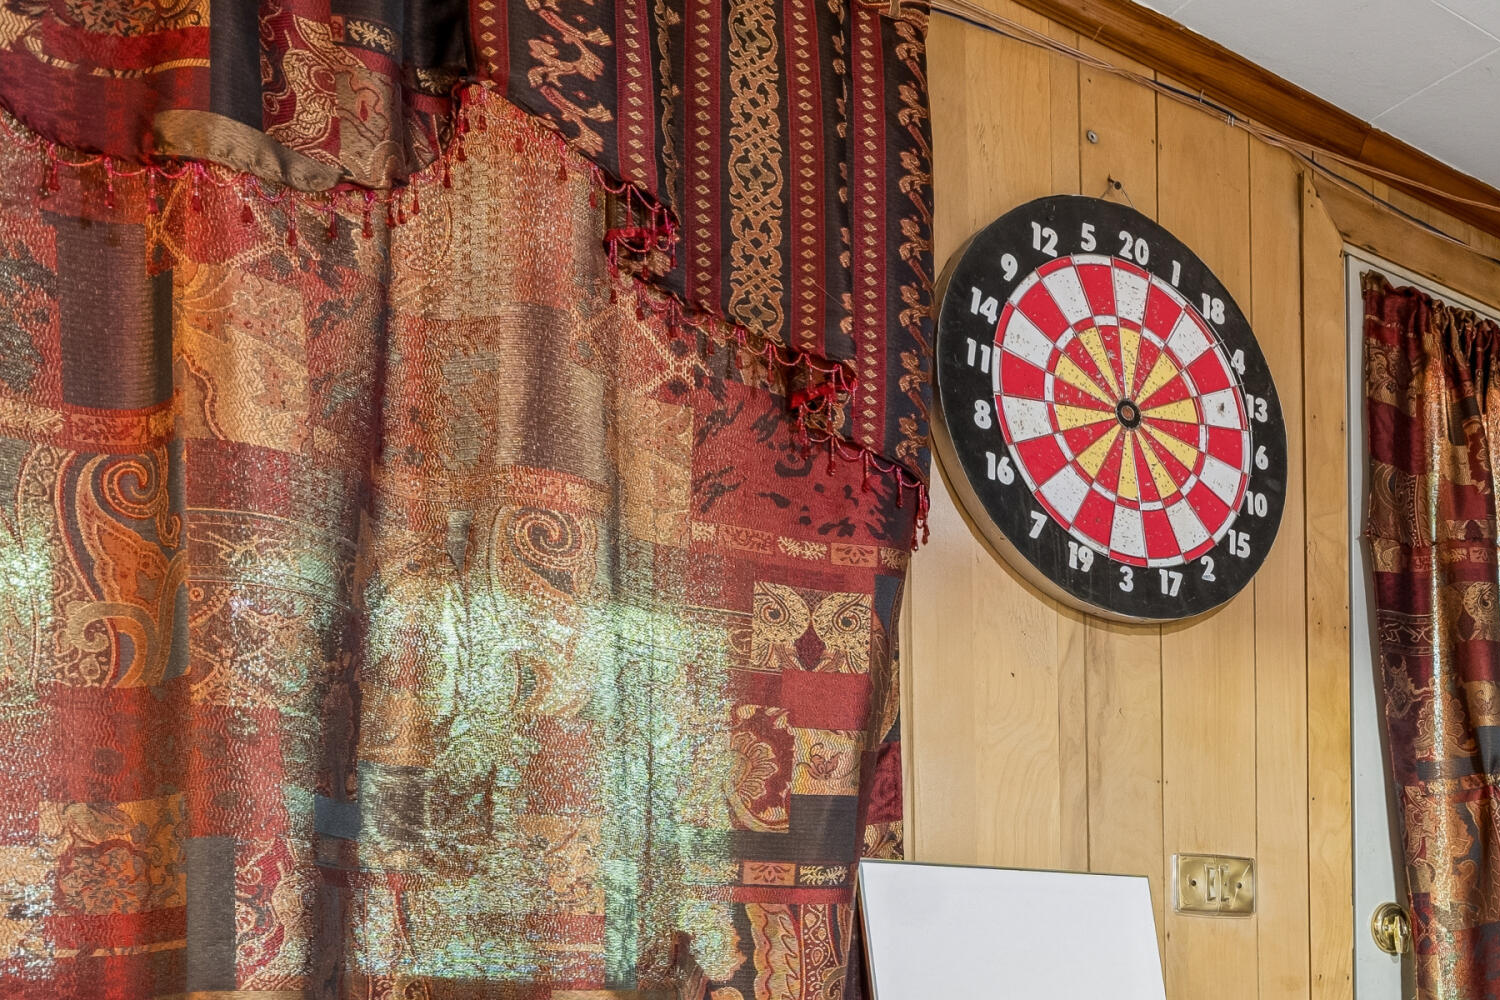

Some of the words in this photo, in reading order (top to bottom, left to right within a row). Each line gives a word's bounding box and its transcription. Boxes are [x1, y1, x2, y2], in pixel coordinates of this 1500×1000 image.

[1031, 221, 1059, 258] 12
[1080, 222, 1097, 252] 5
[1118, 230, 1150, 266] 20
[1000, 253, 1018, 282] 9
[1170, 260, 1181, 288] 1
[969, 286, 999, 325] 14
[1201, 292, 1226, 325] 18
[966, 337, 991, 374] 11
[1231, 349, 1247, 375] 4
[973, 399, 992, 430] 8
[1247, 393, 1269, 424] 13
[985, 451, 1015, 485] 16
[1255, 445, 1269, 471] 6
[1244, 490, 1268, 518] 10
[1028, 510, 1048, 540] 7
[1067, 540, 1094, 573] 19
[1227, 528, 1251, 559] 15
[1118, 565, 1134, 593] 3
[1158, 568, 1183, 597] 17
[1200, 555, 1216, 582] 2
